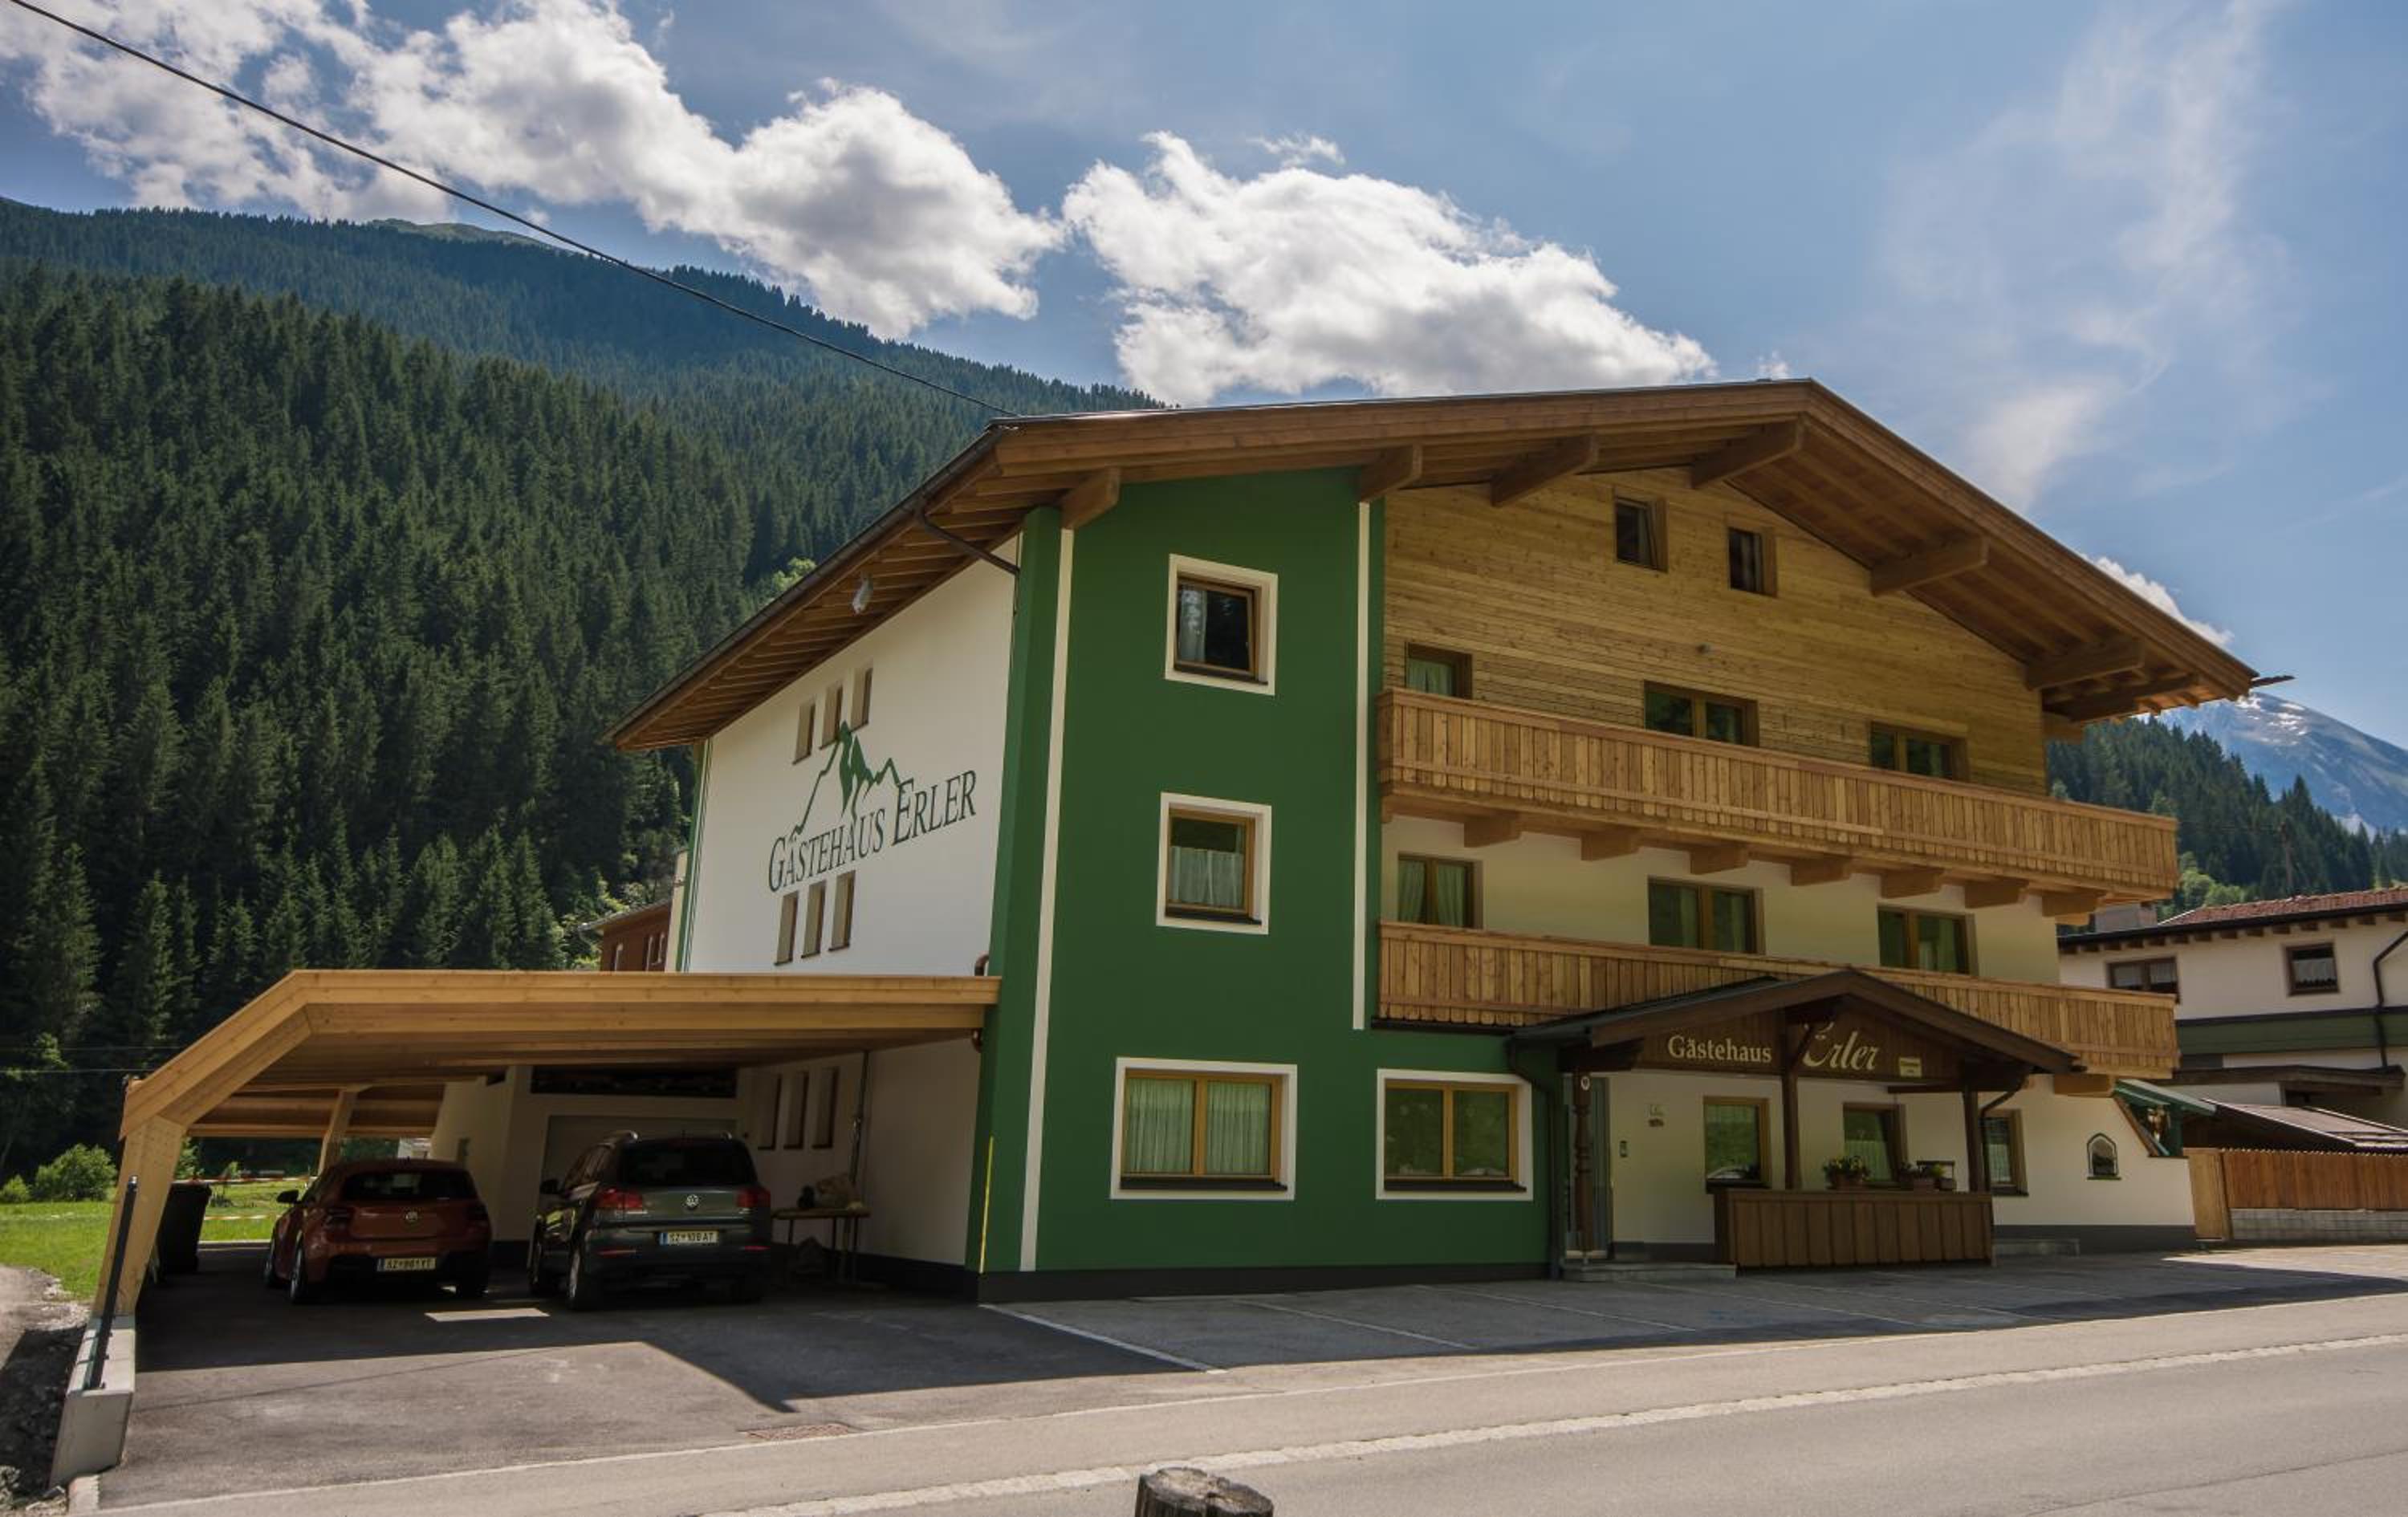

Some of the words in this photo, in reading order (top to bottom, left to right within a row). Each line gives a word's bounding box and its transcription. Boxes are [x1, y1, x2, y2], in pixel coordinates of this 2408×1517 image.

[891, 770, 977, 846] ERLER
[1667, 1034, 1772, 1064] Gästehaus
[1801, 1021, 1880, 1071] Erler
